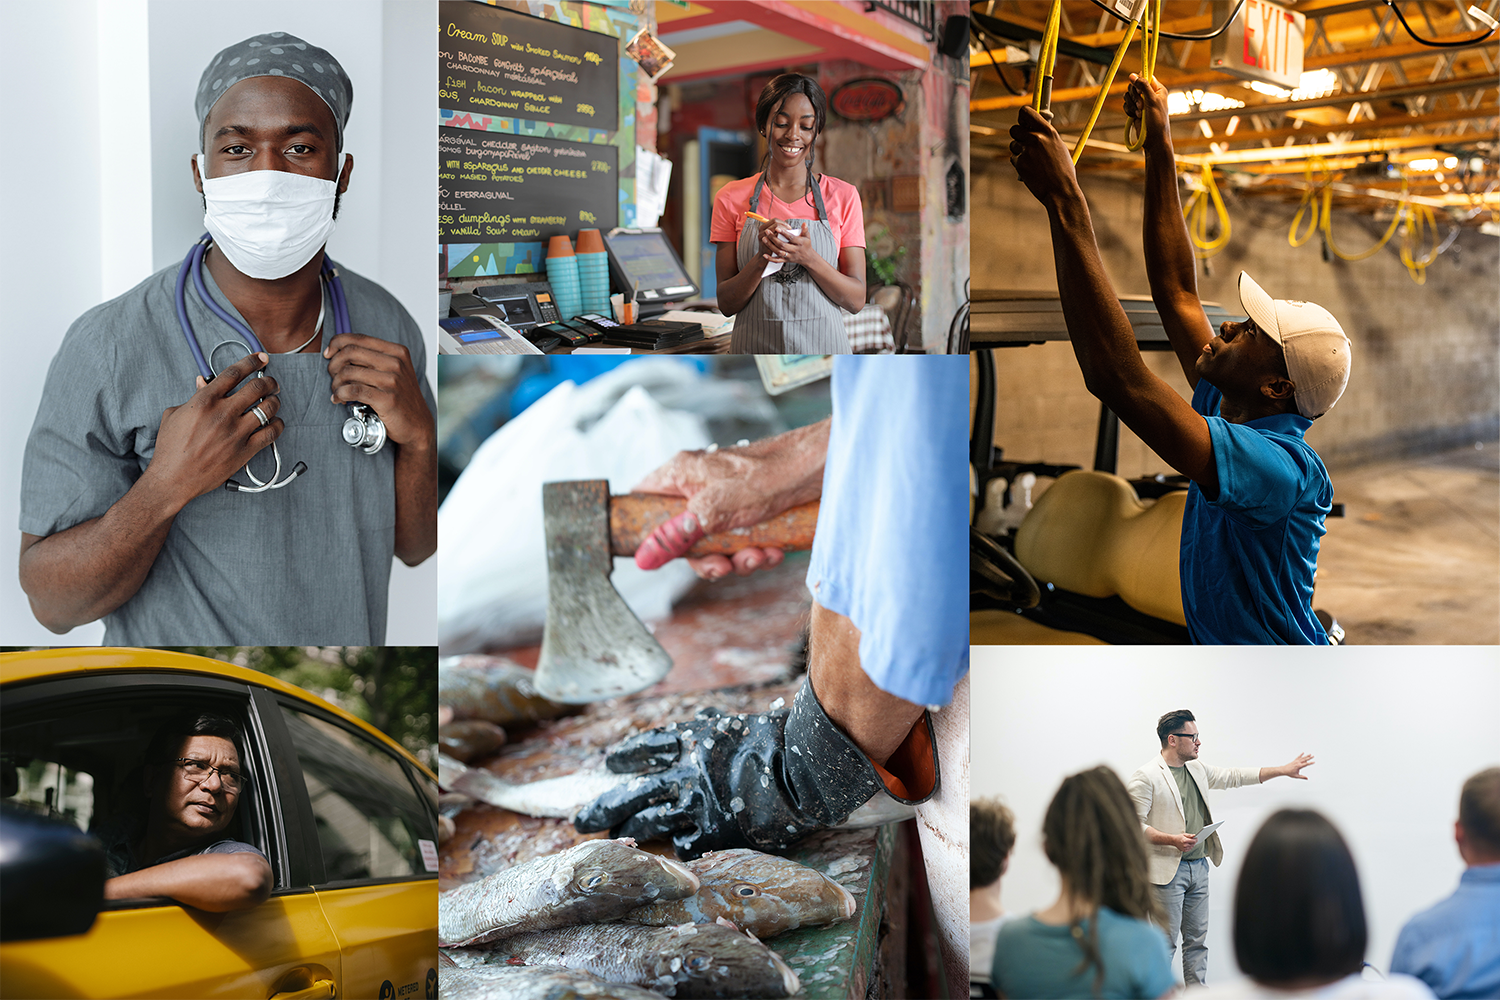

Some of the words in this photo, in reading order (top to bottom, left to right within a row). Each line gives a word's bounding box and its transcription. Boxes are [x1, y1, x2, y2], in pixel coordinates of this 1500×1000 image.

[447, 22, 488, 44] Cream
[491, 32, 509, 46] SOUP
[1243, 0, 1294, 75] EXIT
[446, 62, 500, 78] CHARDONNAY
[469, 96, 519, 110] CHARDONNAY
[460, 173, 487, 181] MASHED
[553, 169, 588, 179] CHEESE
[458, 211, 511, 229] dumplings
